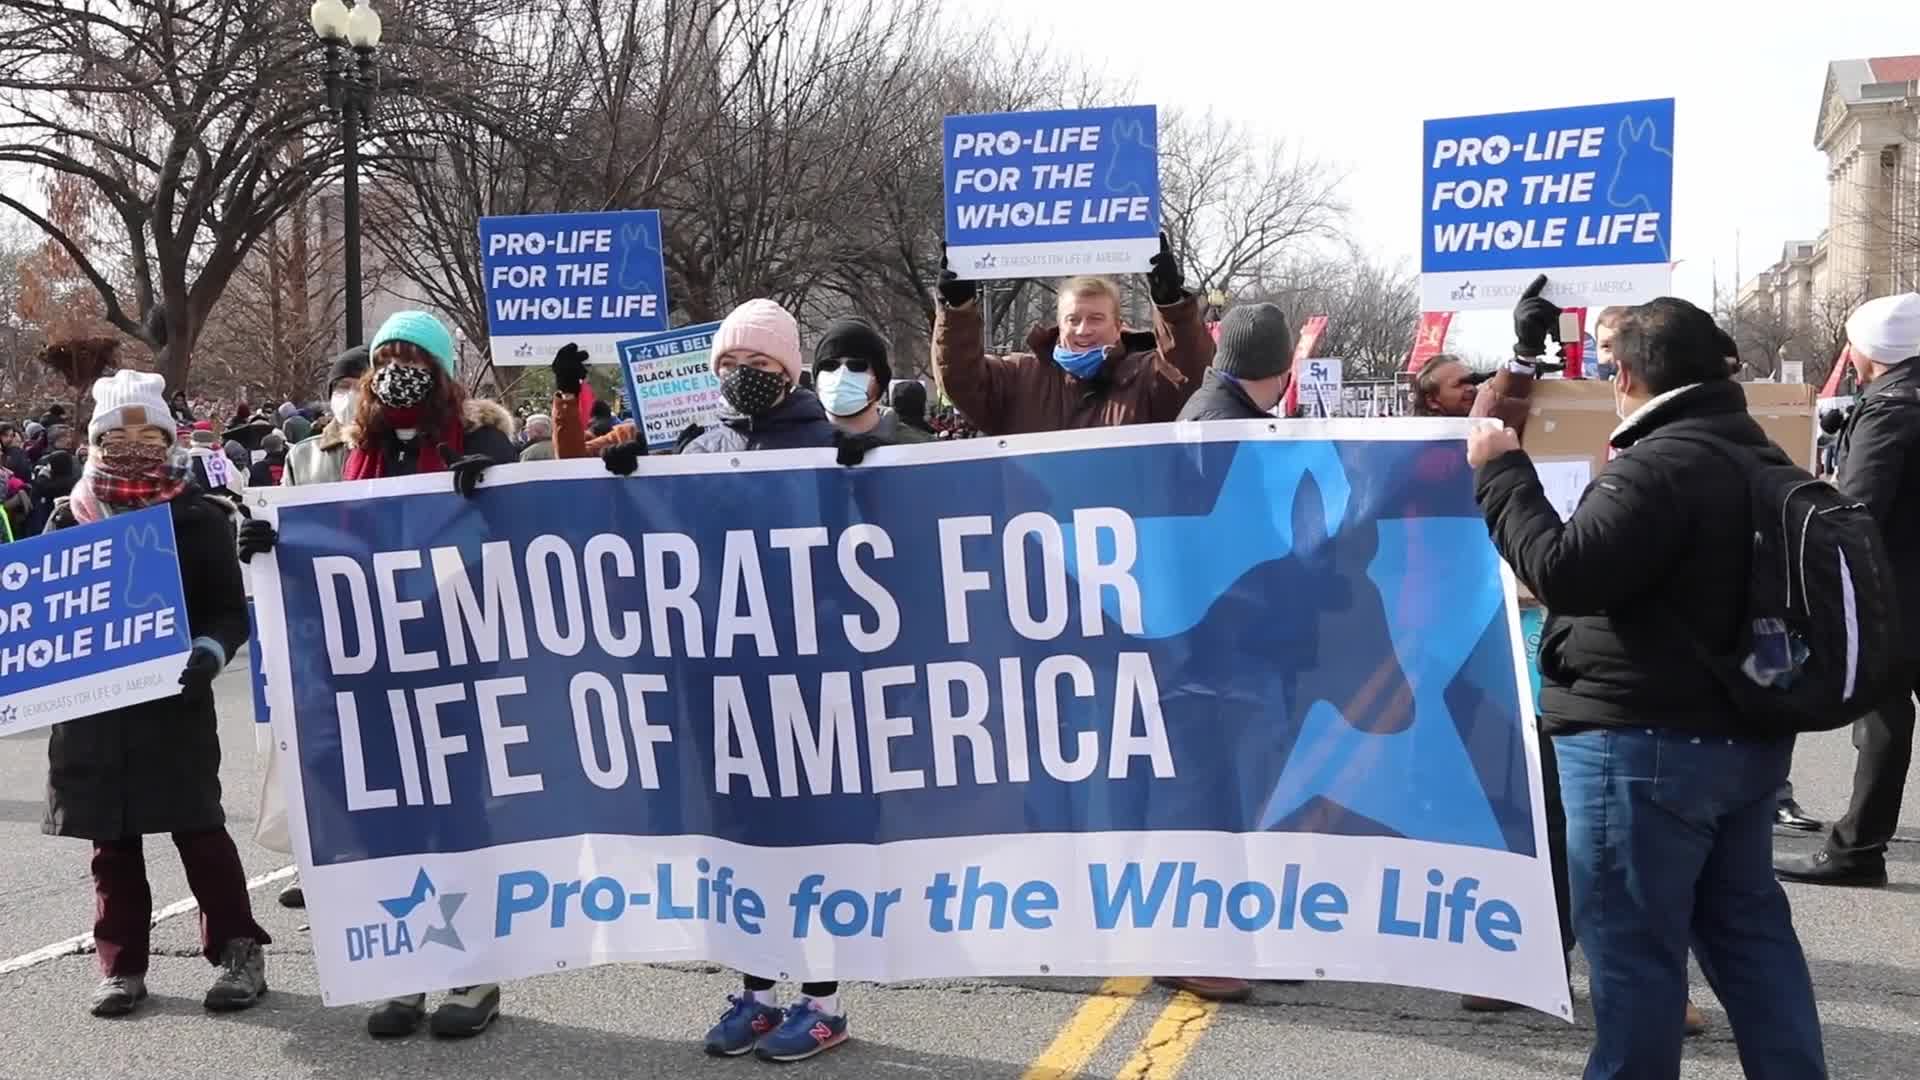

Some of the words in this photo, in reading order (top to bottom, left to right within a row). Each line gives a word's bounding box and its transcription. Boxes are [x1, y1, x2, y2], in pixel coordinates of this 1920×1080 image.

[953, 126, 1101, 158] PRO-LIFE
[1432, 127, 1605, 168] PRO-LIFE
[954, 167, 1021, 194] FOR
[1032, 163, 1095, 190] THE
[1431, 178, 1508, 211] FOR
[1521, 171, 1596, 205] THE
[956, 200, 1072, 230] WHOLE
[1080, 196, 1150, 224] LIFE
[488, 229, 612, 256] PRO-LIFE
[1433, 217, 1567, 253] WHOLE
[1576, 212, 1660, 246] LIFE
[491, 265, 547, 288] FOR
[556, 263, 609, 286] THE
[495, 296, 593, 321] WHOLE
[600, 294, 657, 318] LIFE
[655, 341, 679, 357] WE
[682, 334, 713, 353] BEL
[636, 370, 673, 384] BLACK
[676, 362, 709, 377] LIVES
[640, 377, 700, 399] SCIENCE
[706, 375, 718, 388] IS
[646, 420, 662, 432] NO
[649, 432, 666, 441] PRO
[667, 429, 681, 439] LIF
[0, 538, 113, 591] O-LIFE
[43, 581, 111, 623] THE
[312, 523, 901, 675] DEMOCRATS
[938, 507, 1144, 644] FOR
[0, 626, 93, 677] HOLE
[104, 607, 175, 651] LIFE
[22, 696, 73, 718] DEMOCRATS
[125, 673, 164, 692] AMERICA
[336, 675, 544, 812] LIFE
[569, 671, 673, 790] OF
[713, 651, 1176, 797] AMERICA
[494, 857, 765, 938] Pro-Life
[788, 874, 902, 938] for
[925, 865, 1059, 934] the
[1087, 860, 1349, 932] Whole
[1377, 868, 1523, 952] Life
[345, 920, 413, 962] DFLA
